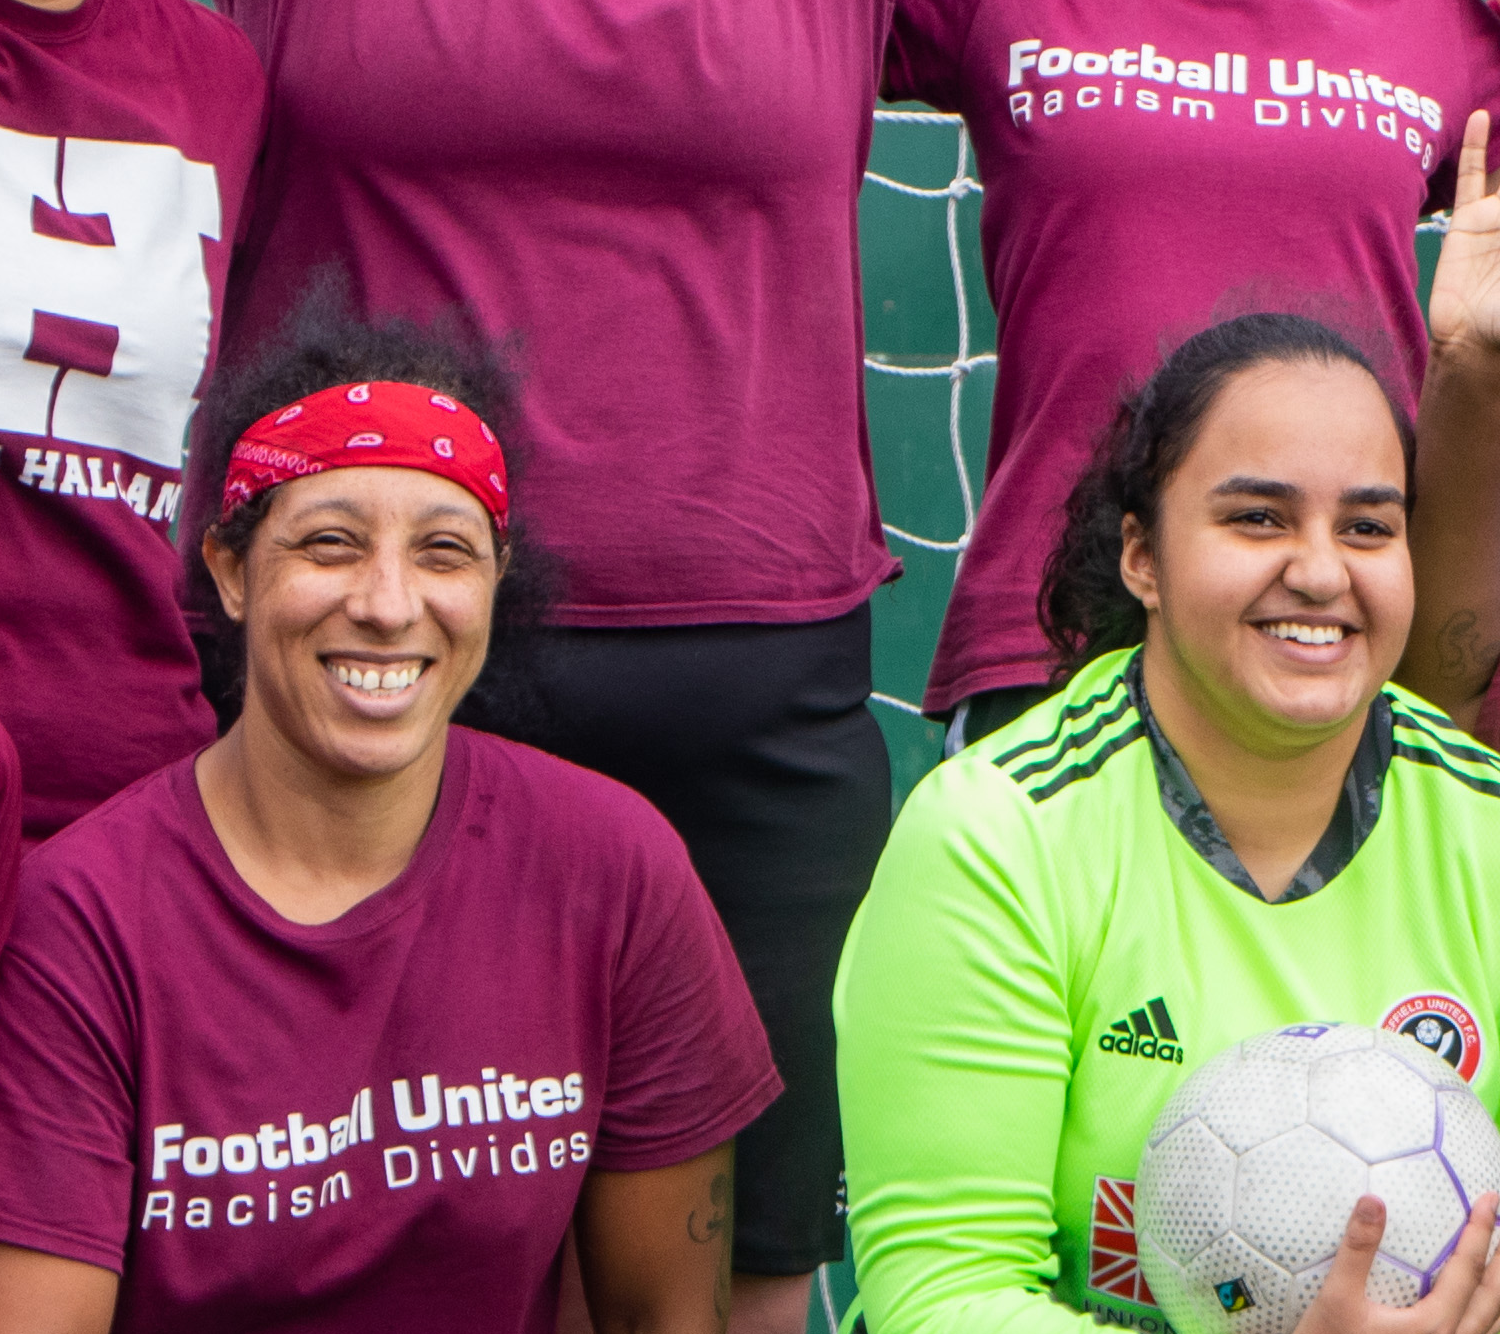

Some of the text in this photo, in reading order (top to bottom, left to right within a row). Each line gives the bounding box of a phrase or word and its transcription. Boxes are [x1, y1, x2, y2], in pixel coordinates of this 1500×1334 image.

[1007, 39, 1443, 132] Football Unites
[1008, 81, 1433, 169] Racism Divides
[1098, 1032, 1184, 1065] adidas
[1426, 999, 1467, 1024] UNITED
[151, 1067, 584, 1180] Football Unites
[141, 1131, 591, 1230] Racism Divides
